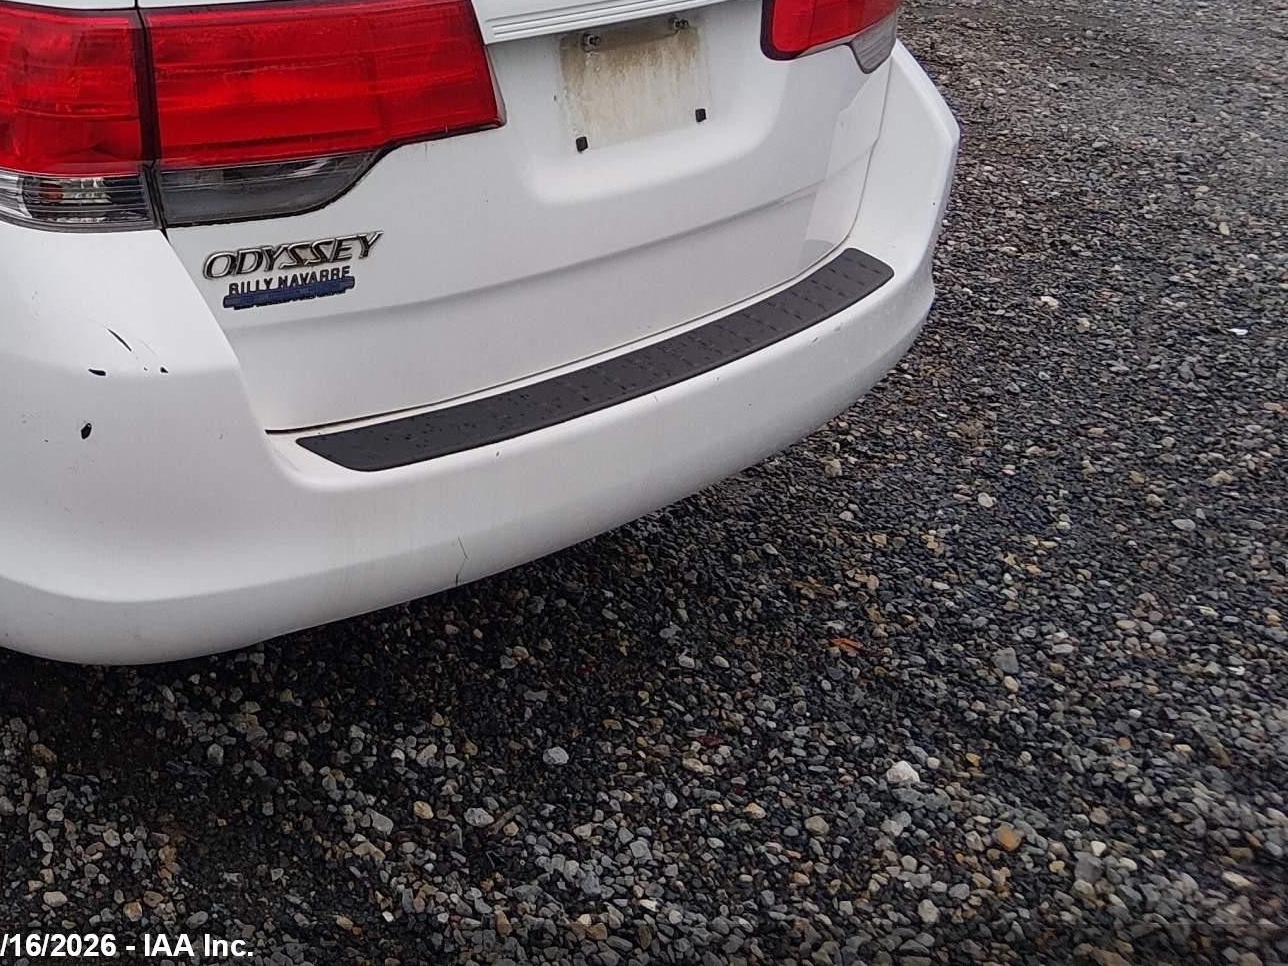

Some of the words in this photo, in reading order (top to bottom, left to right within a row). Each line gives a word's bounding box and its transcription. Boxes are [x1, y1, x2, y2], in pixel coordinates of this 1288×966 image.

[203, 231, 384, 280] ODYSSEY
[228, 277, 273, 296] BILLY
[278, 266, 351, 290] NAVARRE
